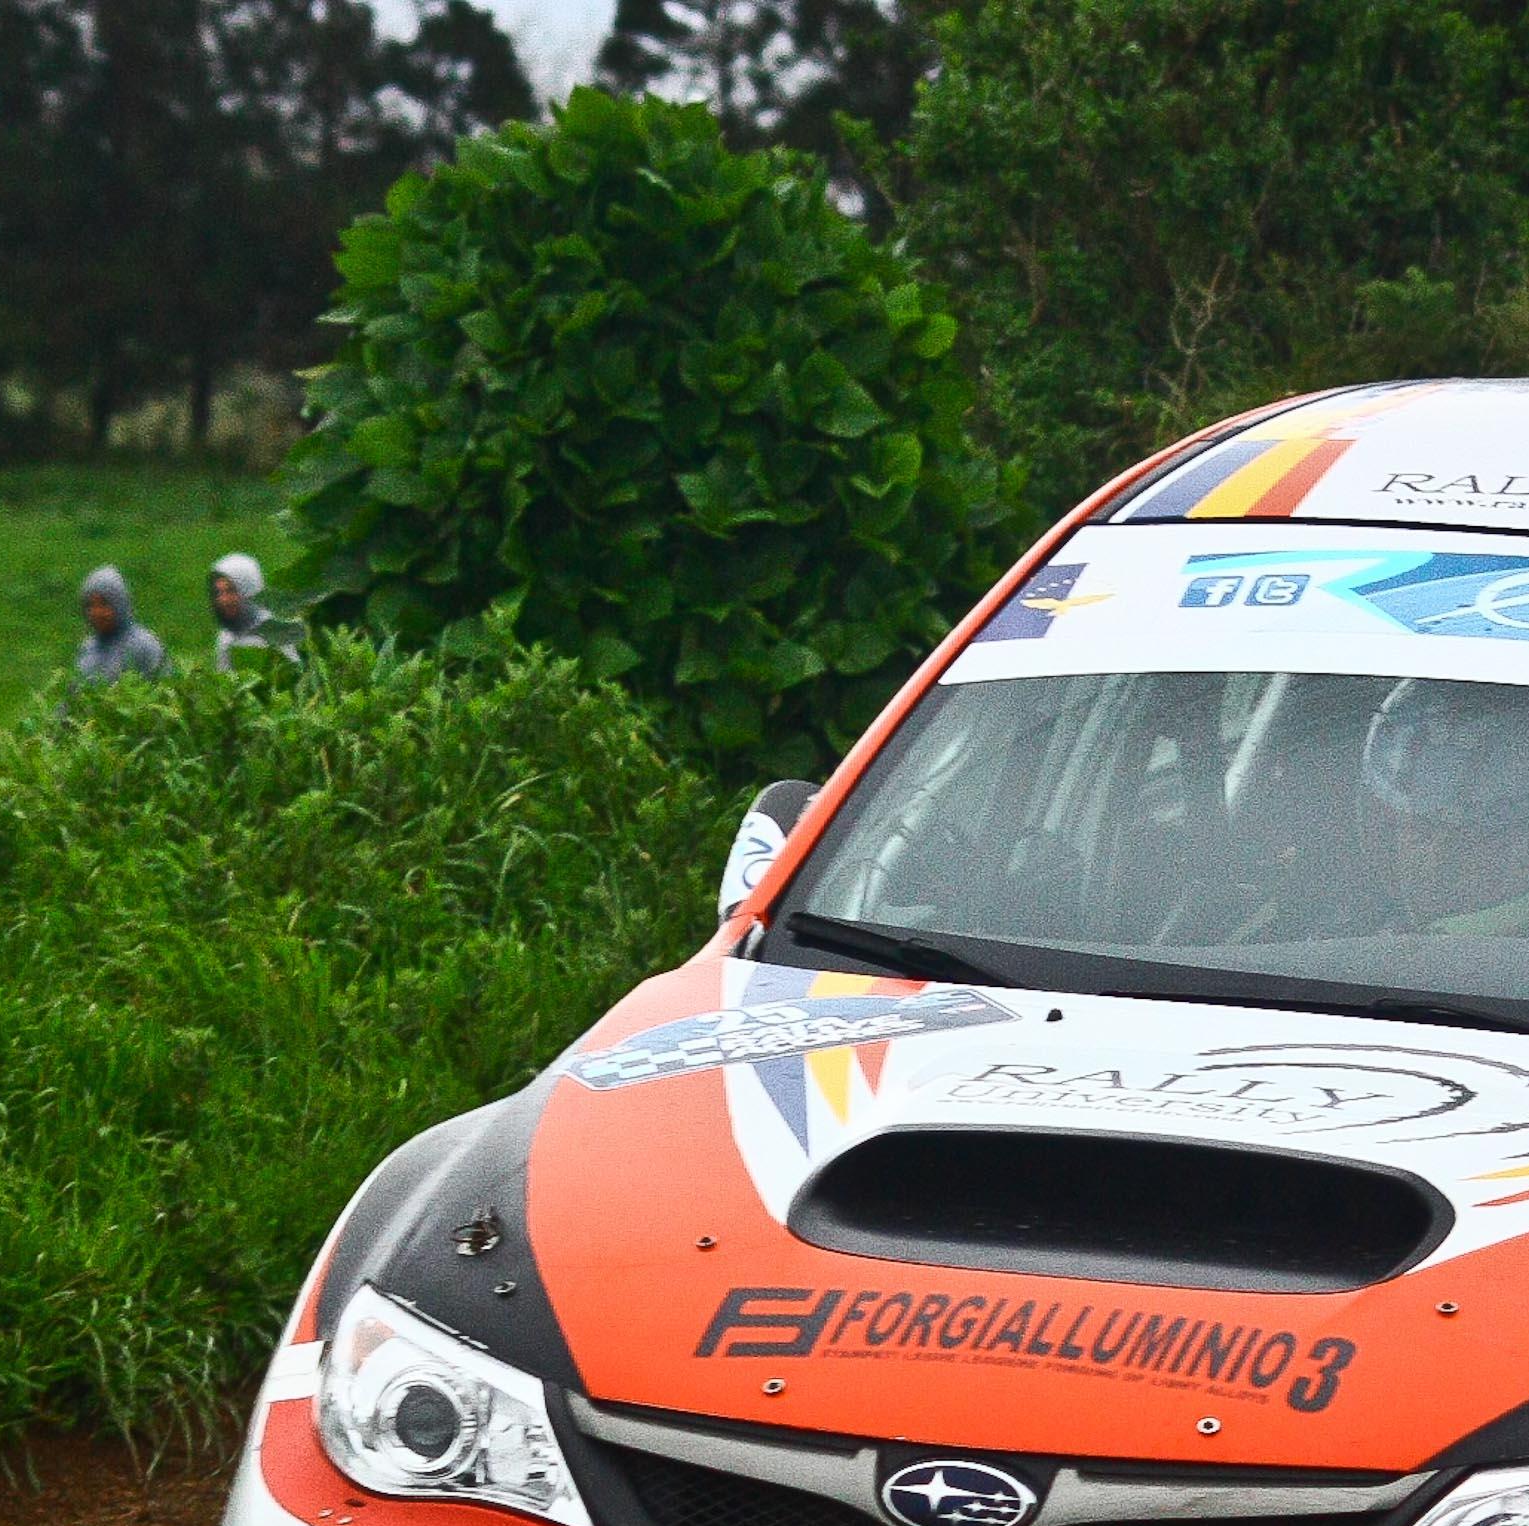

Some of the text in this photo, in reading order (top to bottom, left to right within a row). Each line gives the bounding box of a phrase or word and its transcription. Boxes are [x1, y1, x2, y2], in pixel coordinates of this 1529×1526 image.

[947, 1083, 1328, 1125] University
[966, 1063, 1394, 1110] RALLY
[829, 1290, 1357, 1413] FORGIALLUMINIO 3
